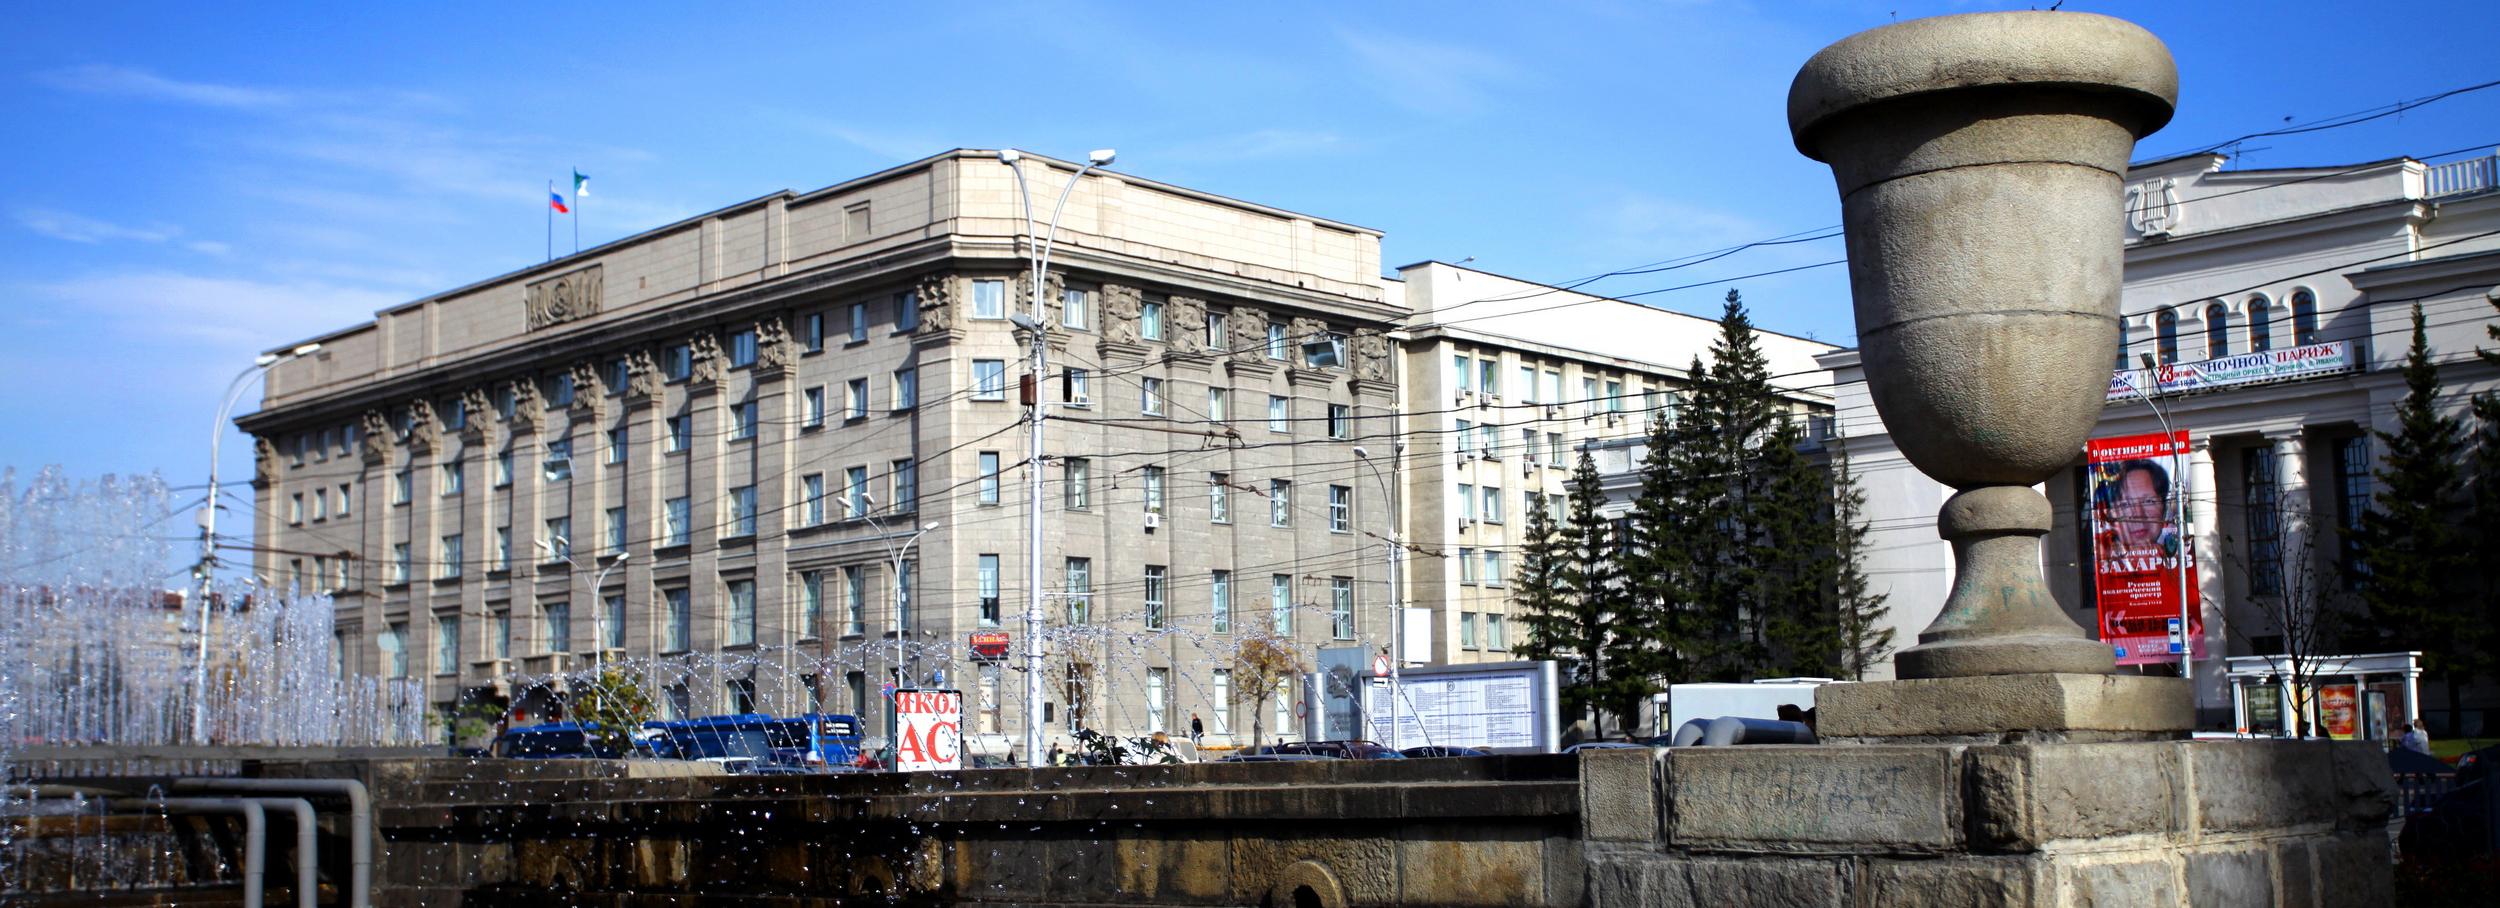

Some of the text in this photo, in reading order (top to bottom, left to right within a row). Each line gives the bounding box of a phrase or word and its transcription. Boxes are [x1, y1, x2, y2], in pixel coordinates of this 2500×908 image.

[2277, 342, 2342, 363] ПАРИЖ"
[2158, 364, 2174, 383] 23
[2100, 444, 2153, 457] ОКТЯБРЯ
[2100, 555, 2194, 574] ЗАХАРОВ
[897, 721, 956, 764] АС
